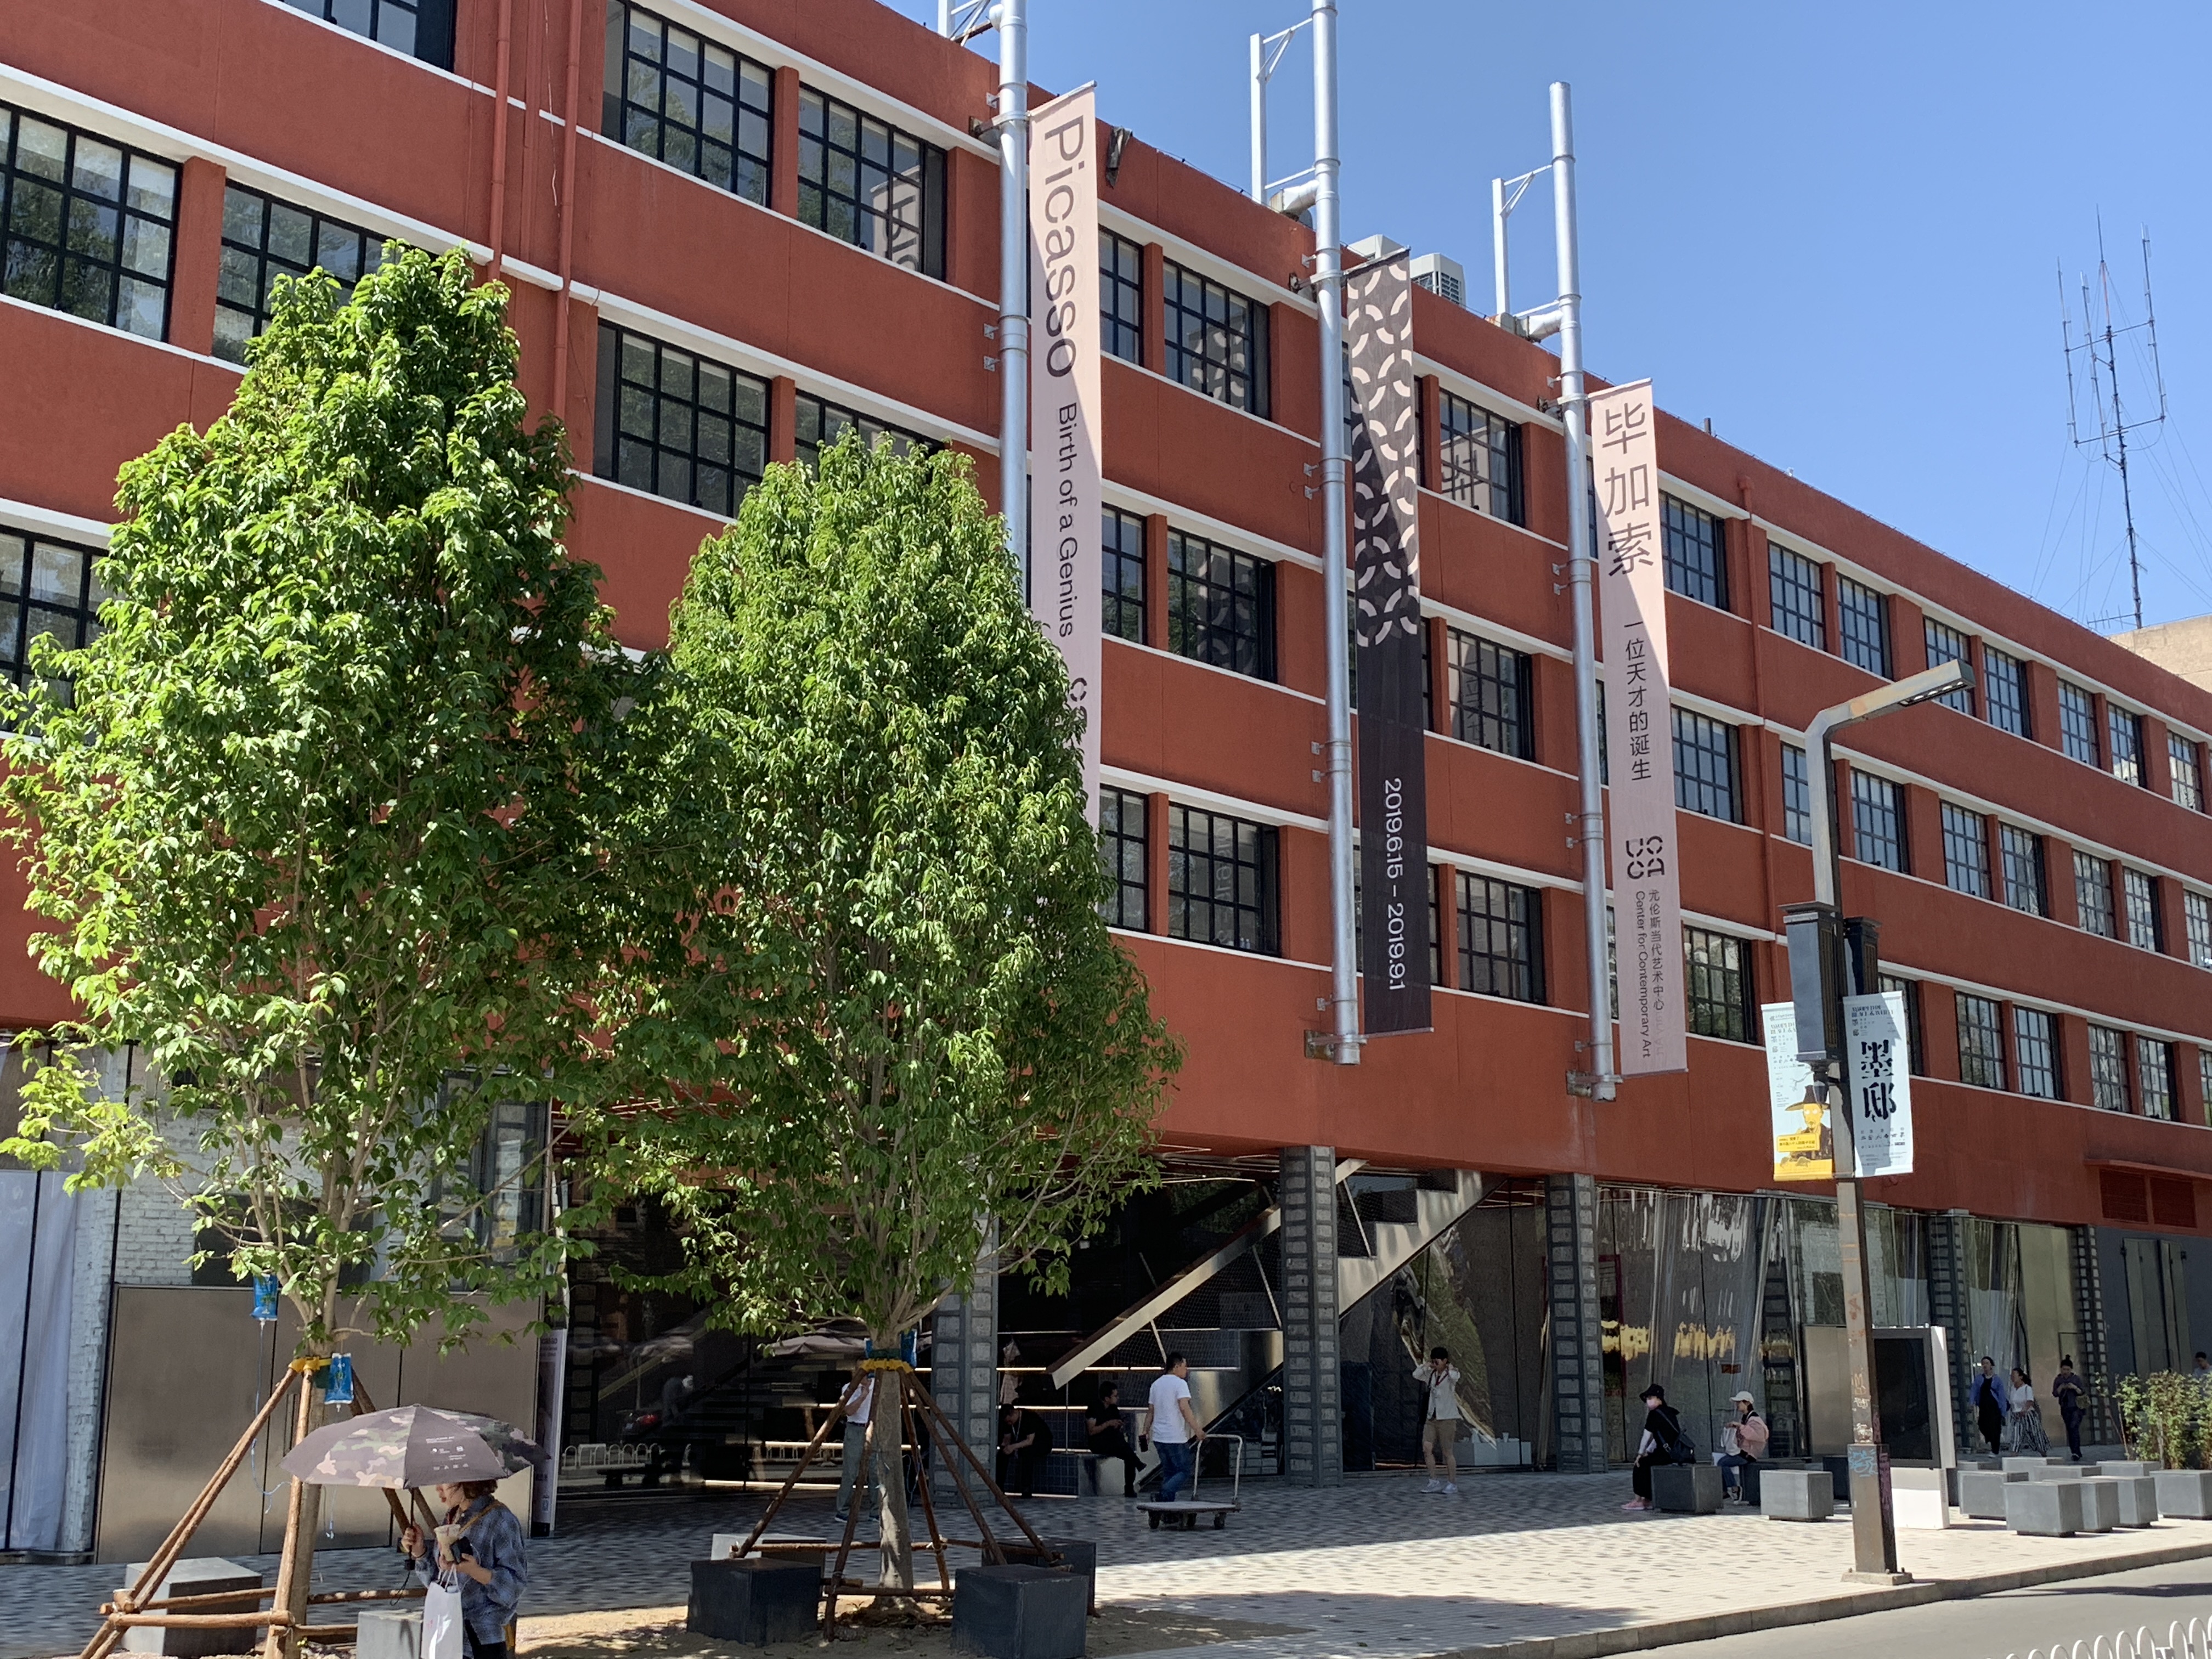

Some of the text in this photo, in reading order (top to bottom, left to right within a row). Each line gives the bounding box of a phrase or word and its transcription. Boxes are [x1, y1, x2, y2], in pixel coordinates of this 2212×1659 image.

[1043, 115, 1085, 377] Picasso
[1058, 403, 1078, 637] Birth of a Genius
[1602, 402, 1654, 577] 毕加索
[1624, 621, 1651, 781] 一位天才的诞生
[1385, 778, 1403, 878] 2019.6.15
[1388, 903, 1406, 990] 2019.9.1
[1635, 891, 1651, 1058] Center for Contemporary Art
[1649, 889, 1664, 1011] 尤伦斯当代艺术中心
[1861, 1040, 1897, 1122] 墨邸
